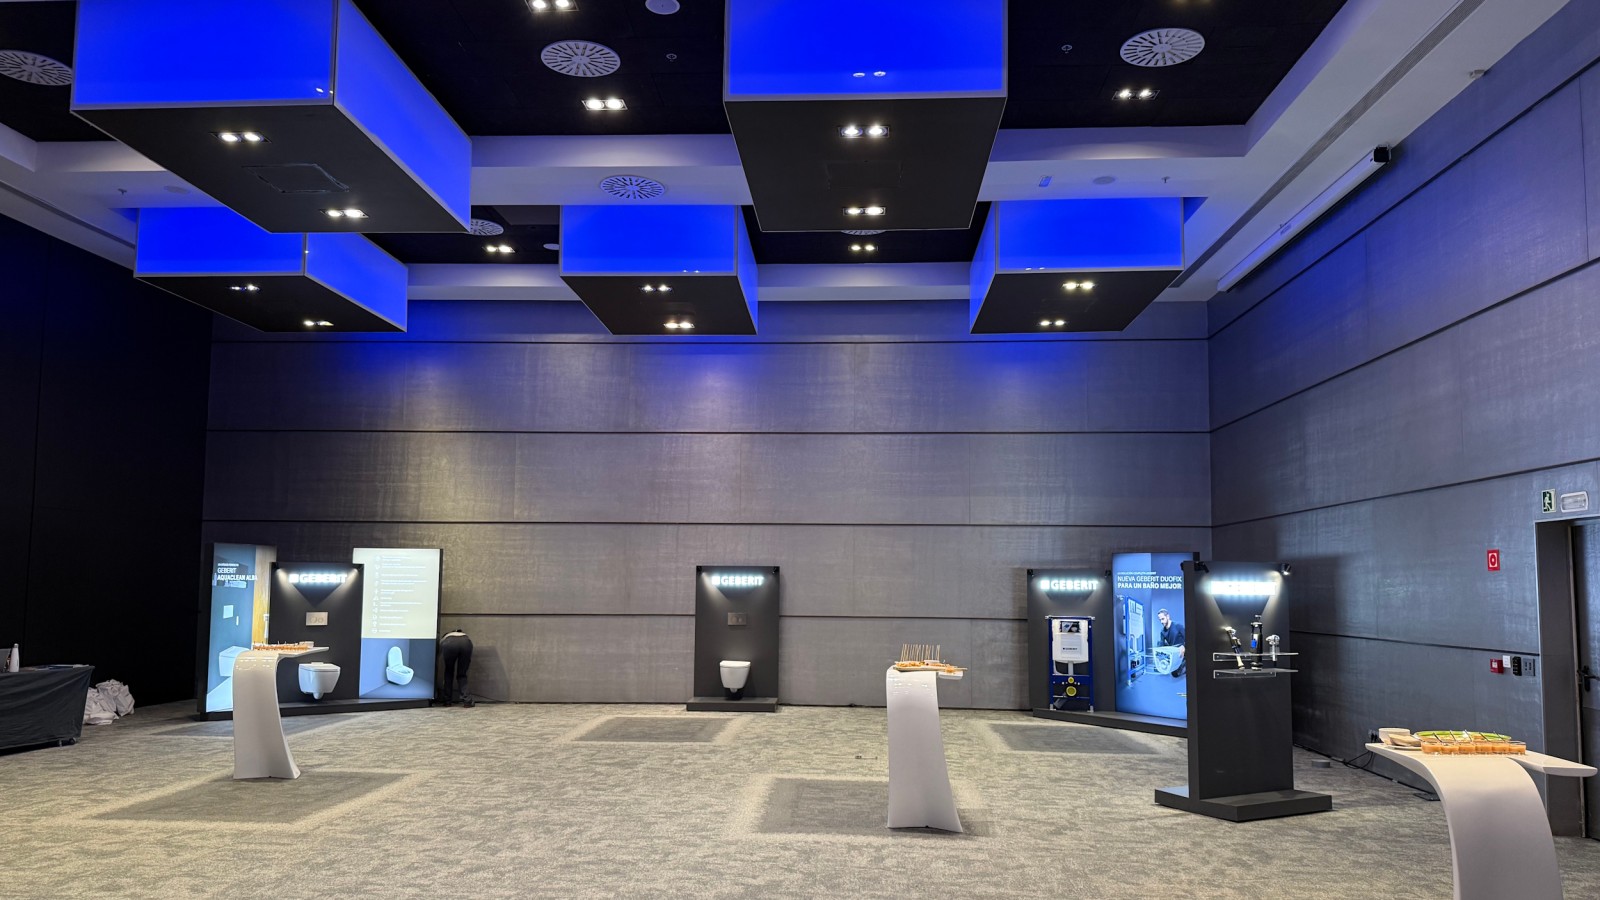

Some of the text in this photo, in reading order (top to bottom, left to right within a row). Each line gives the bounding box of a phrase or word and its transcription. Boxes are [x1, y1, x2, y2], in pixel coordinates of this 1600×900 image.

[720, 575, 765, 586] GEBERIT
[1117, 575, 1136, 583] NUEVA
[1136, 575, 1159, 583] GEBERIT
[1050, 579, 1099, 590] GEBERIT
[1142, 582, 1160, 590] BAÑO
